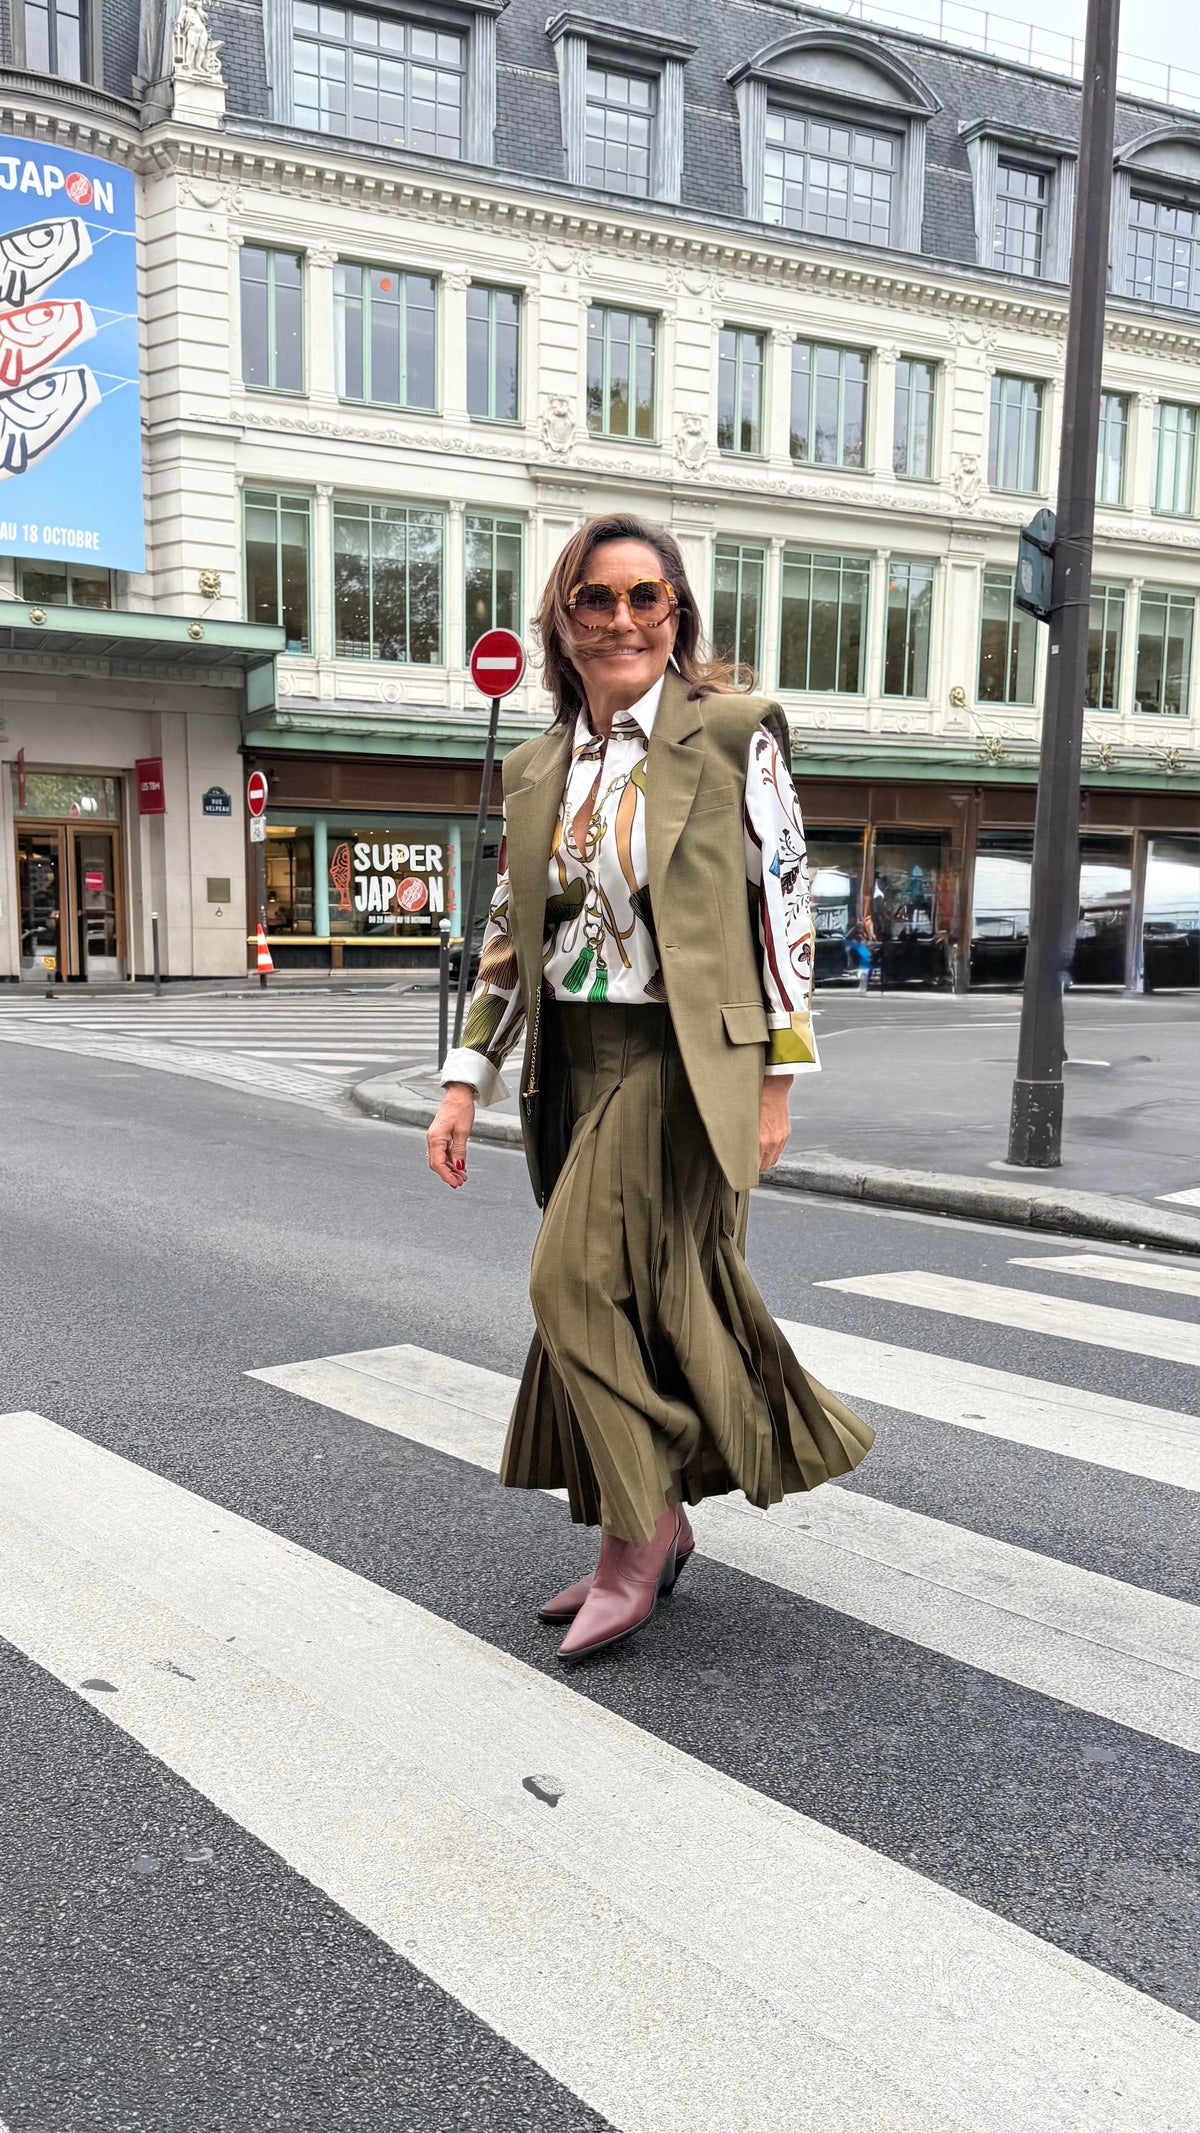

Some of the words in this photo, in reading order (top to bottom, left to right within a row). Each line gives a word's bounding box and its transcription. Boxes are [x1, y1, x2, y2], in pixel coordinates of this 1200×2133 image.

[0, 156, 114, 214] JAPON
[0, 521, 17, 541] AU
[22, 524, 38, 543] 18
[42, 526, 100, 551] OCTOBRE
[353, 843, 444, 872] SUPER
[354, 876, 444, 913] JAPON
